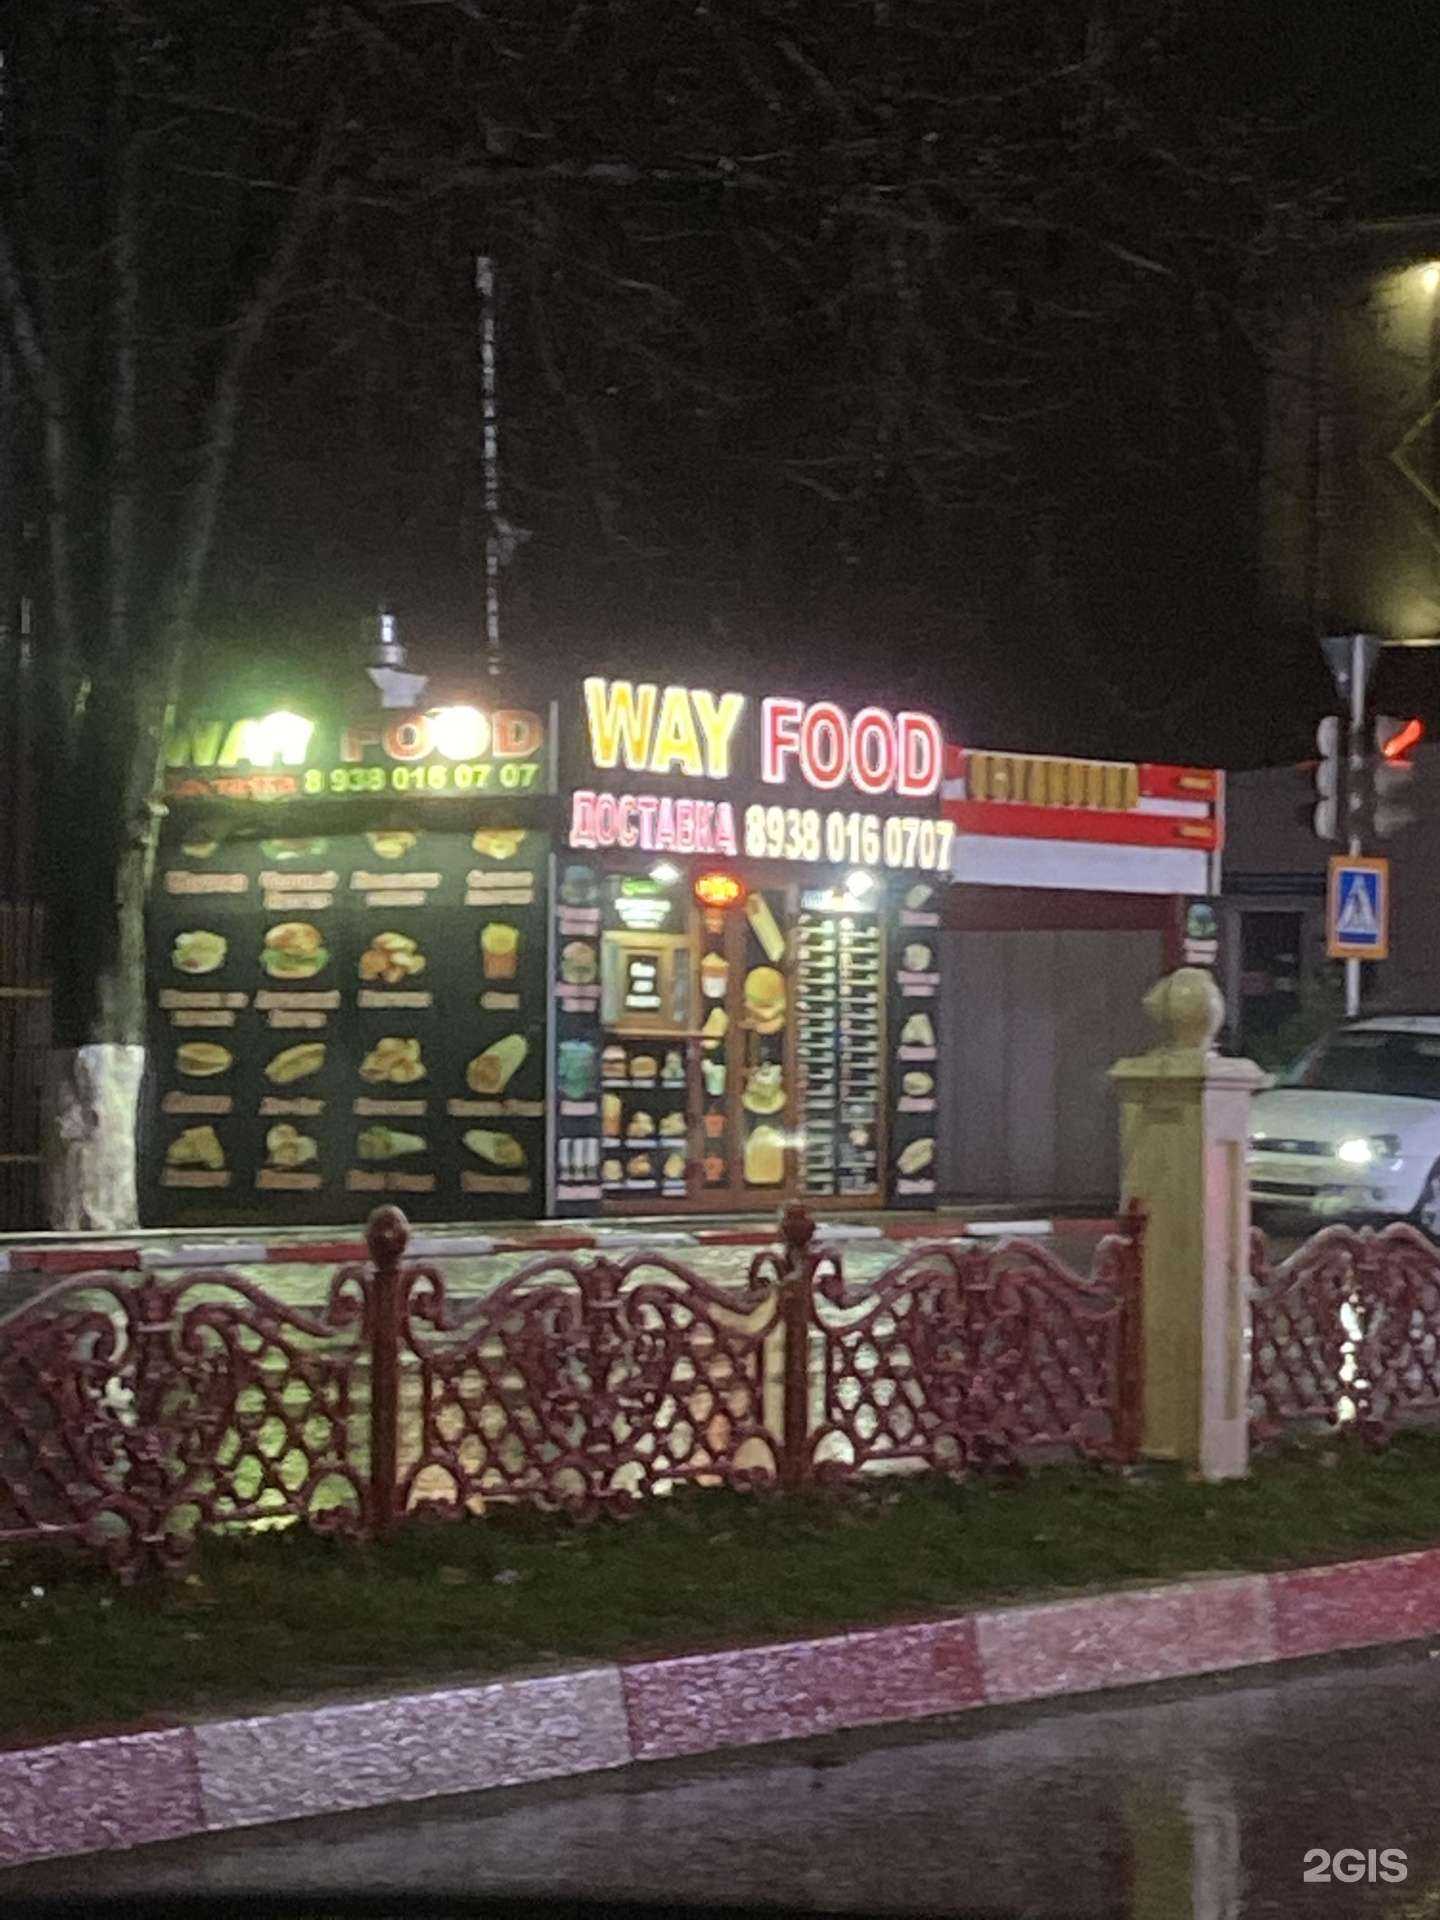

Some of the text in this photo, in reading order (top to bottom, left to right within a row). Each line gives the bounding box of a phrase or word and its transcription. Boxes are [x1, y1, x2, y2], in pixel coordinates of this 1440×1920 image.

[392, 765, 444, 791] 016
[454, 763, 491, 788] 07
[501, 763, 539, 788] 07
[584, 676, 744, 778] WAY
[760, 697, 942, 796] FOOD
[569, 789, 955, 871] ДОСТАВКА 8938 016 0707
